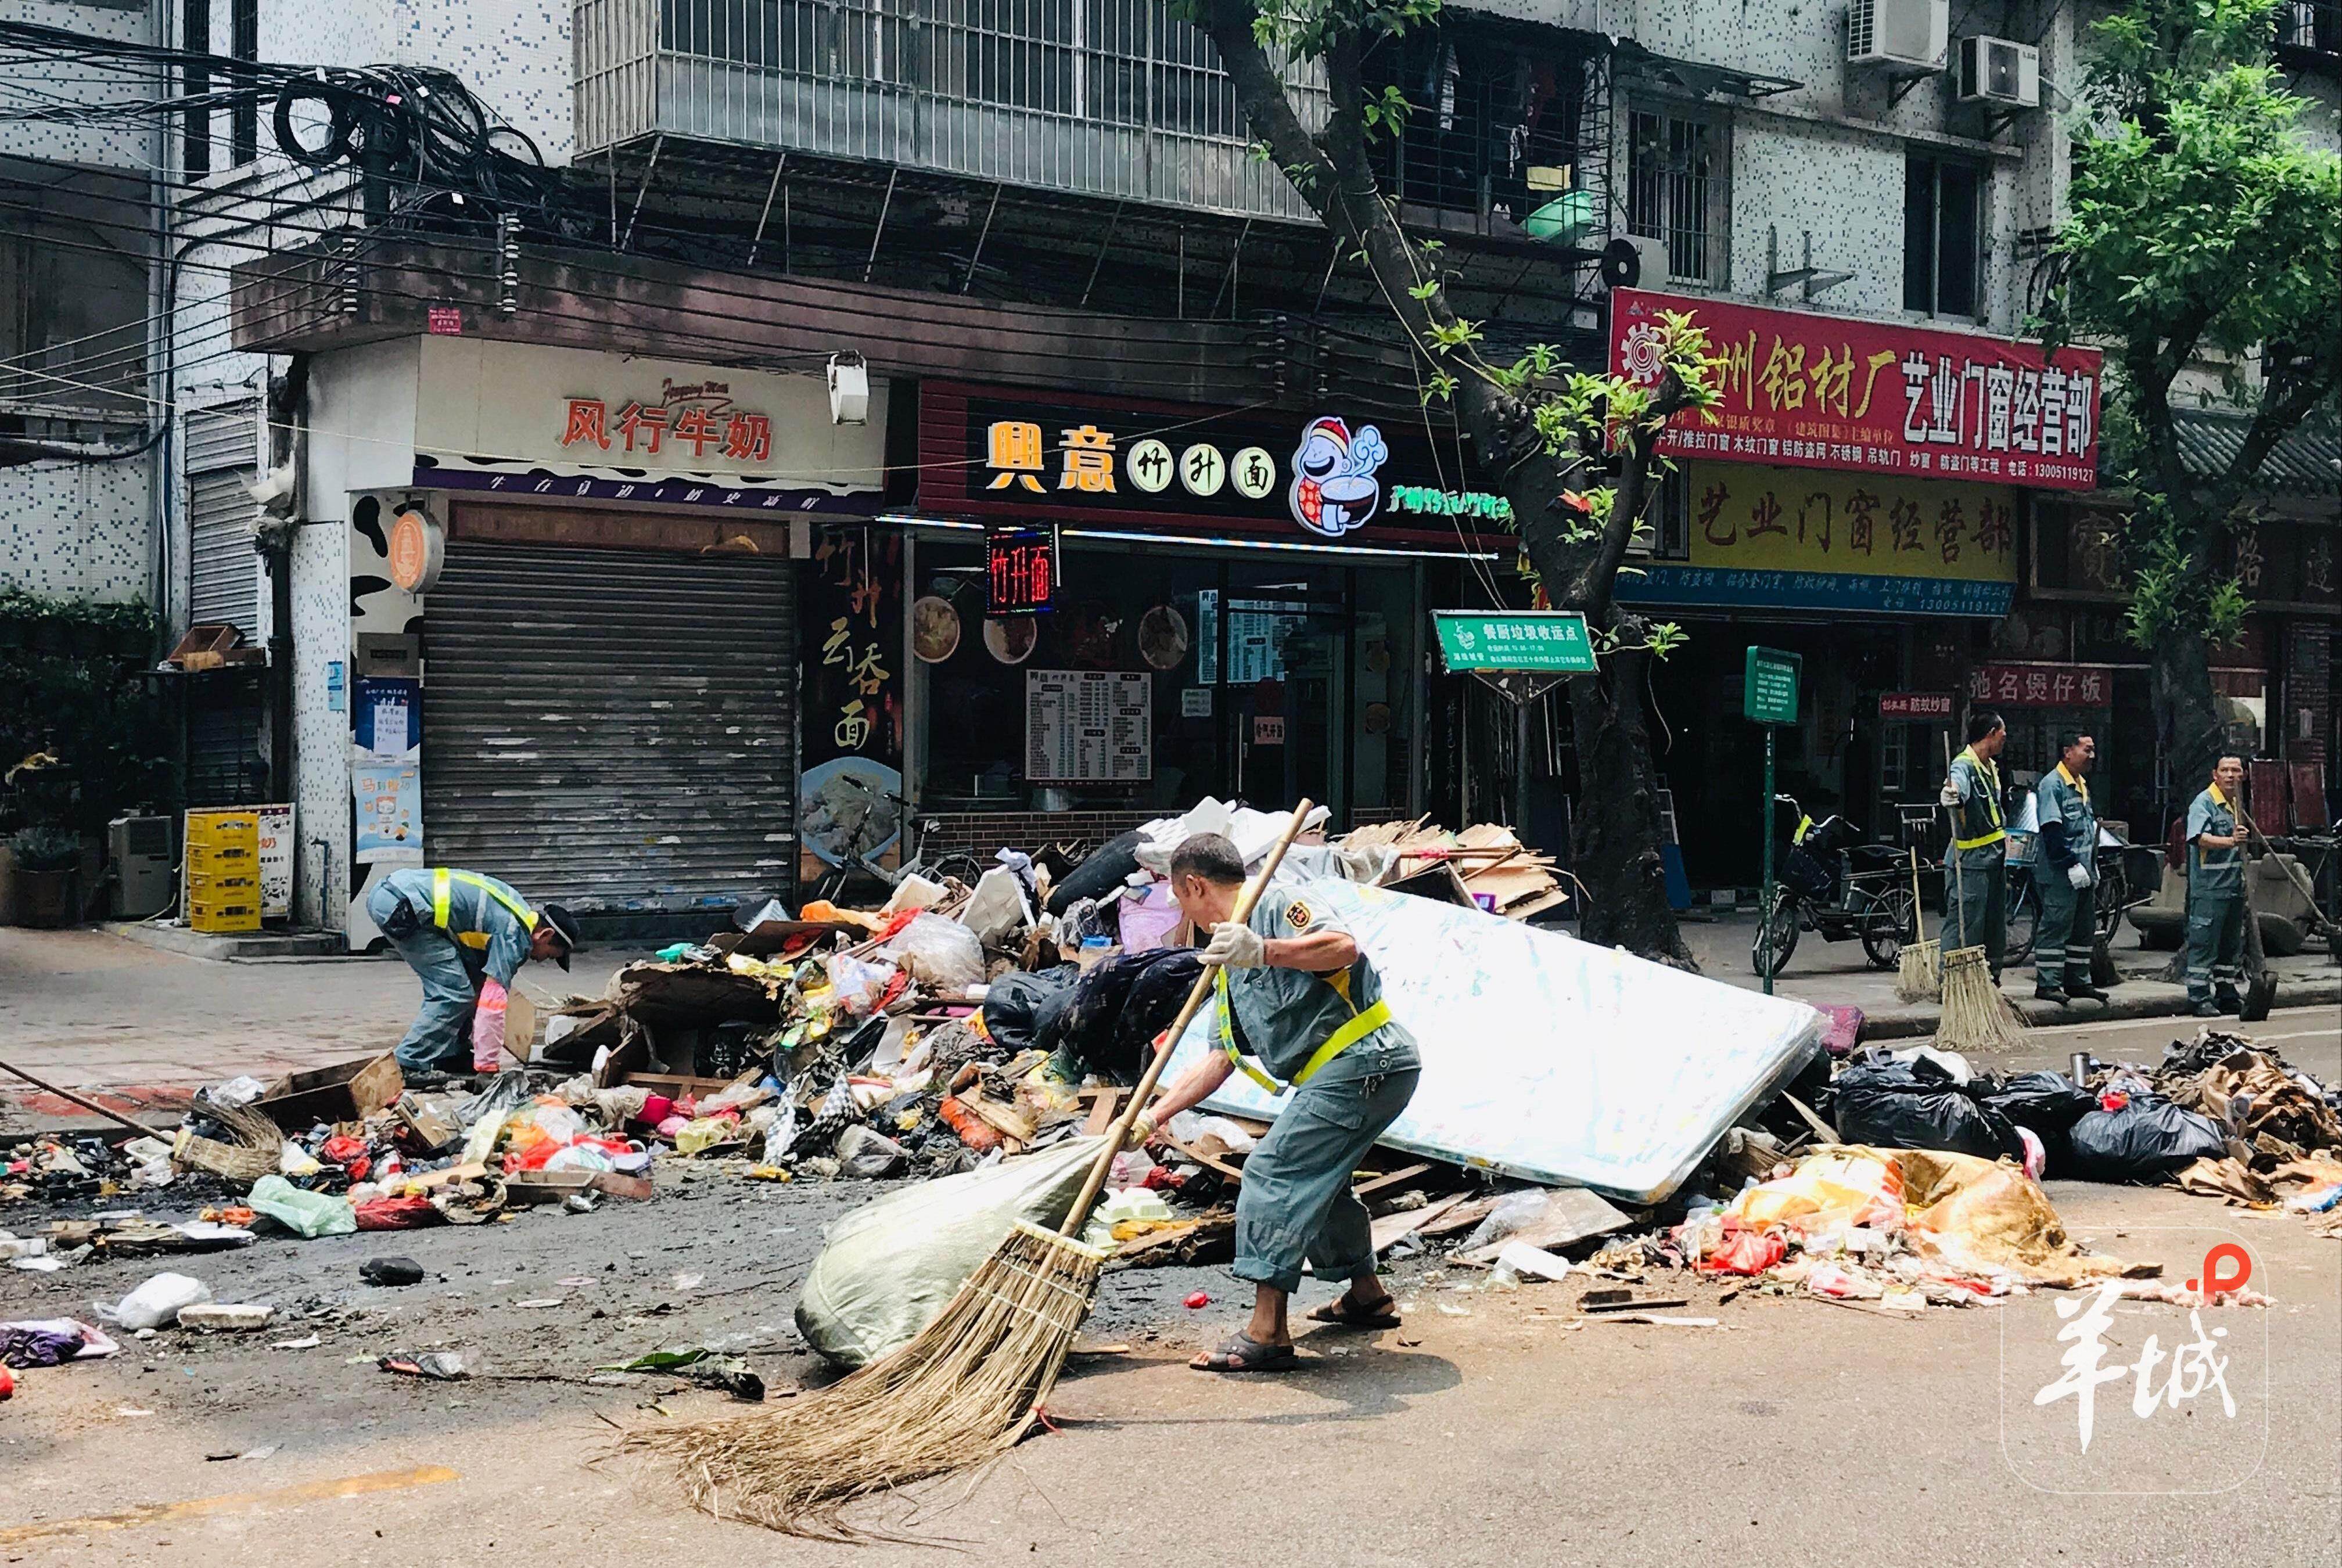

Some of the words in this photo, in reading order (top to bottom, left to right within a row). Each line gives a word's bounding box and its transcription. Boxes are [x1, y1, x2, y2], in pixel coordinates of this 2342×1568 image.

[1715, 329, 1896, 419] 州铝材厂
[1902, 351, 2093, 460] 艺业门窗经营部
[561, 399, 772, 462] 风行牛奶
[986, 421, 1117, 494] 興意
[1137, 446, 1271, 494] 竹升面
[1830, 443, 1862, 464] 不锈钢
[1940, 454, 2000, 475] 防盗门等工程
[1697, 480, 2013, 565] 艺业门窗经营部
[991, 546, 1050, 605] 竹升面
[1483, 623, 1579, 641] 餐厨垃圾收运点
